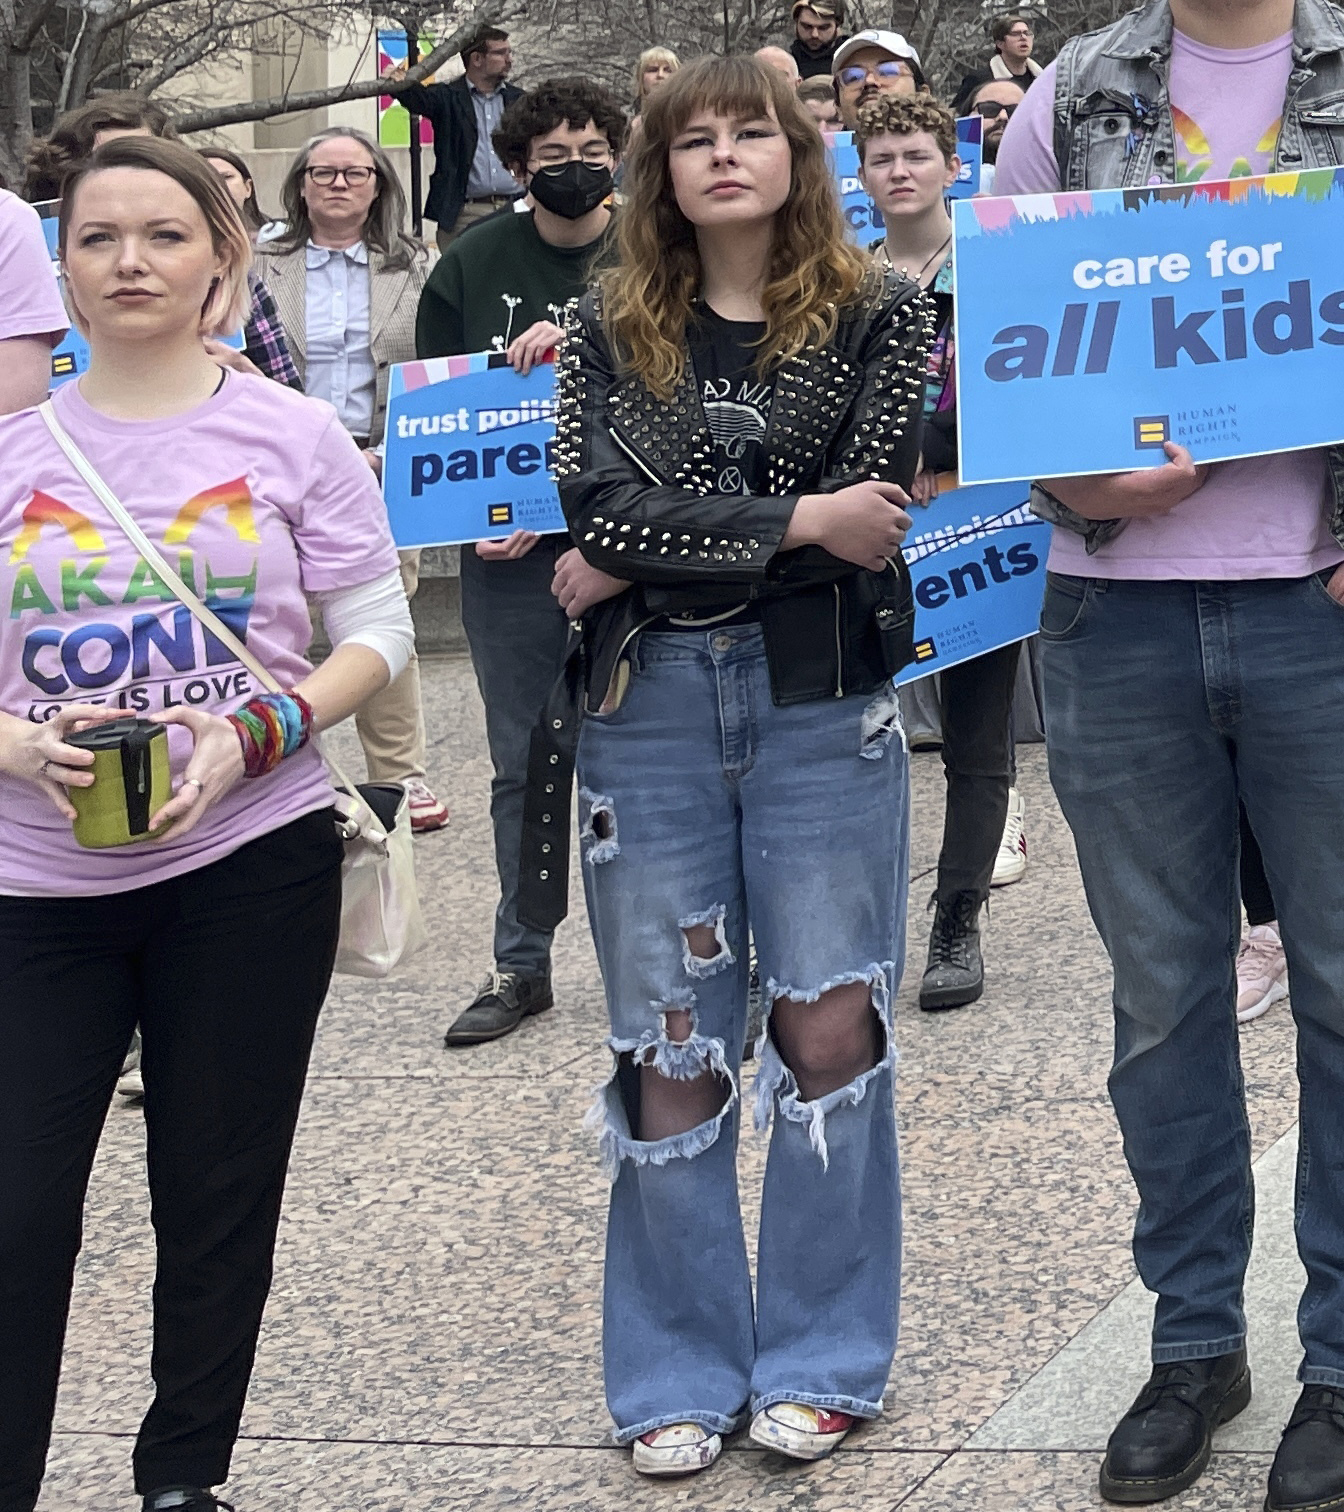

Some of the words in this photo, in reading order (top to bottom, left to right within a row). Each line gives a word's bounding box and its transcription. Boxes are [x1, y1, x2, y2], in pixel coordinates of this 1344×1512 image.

[1073, 248, 1191, 290] care
[1205, 238, 1284, 279] for
[983, 299, 1121, 384] all
[396, 407, 470, 439] trust
[1177, 403, 1238, 422] HUMAN
[1178, 417, 1238, 437] RIGHTS
[119, 686, 149, 713] IS
[164, 672, 252, 708] LOVE
